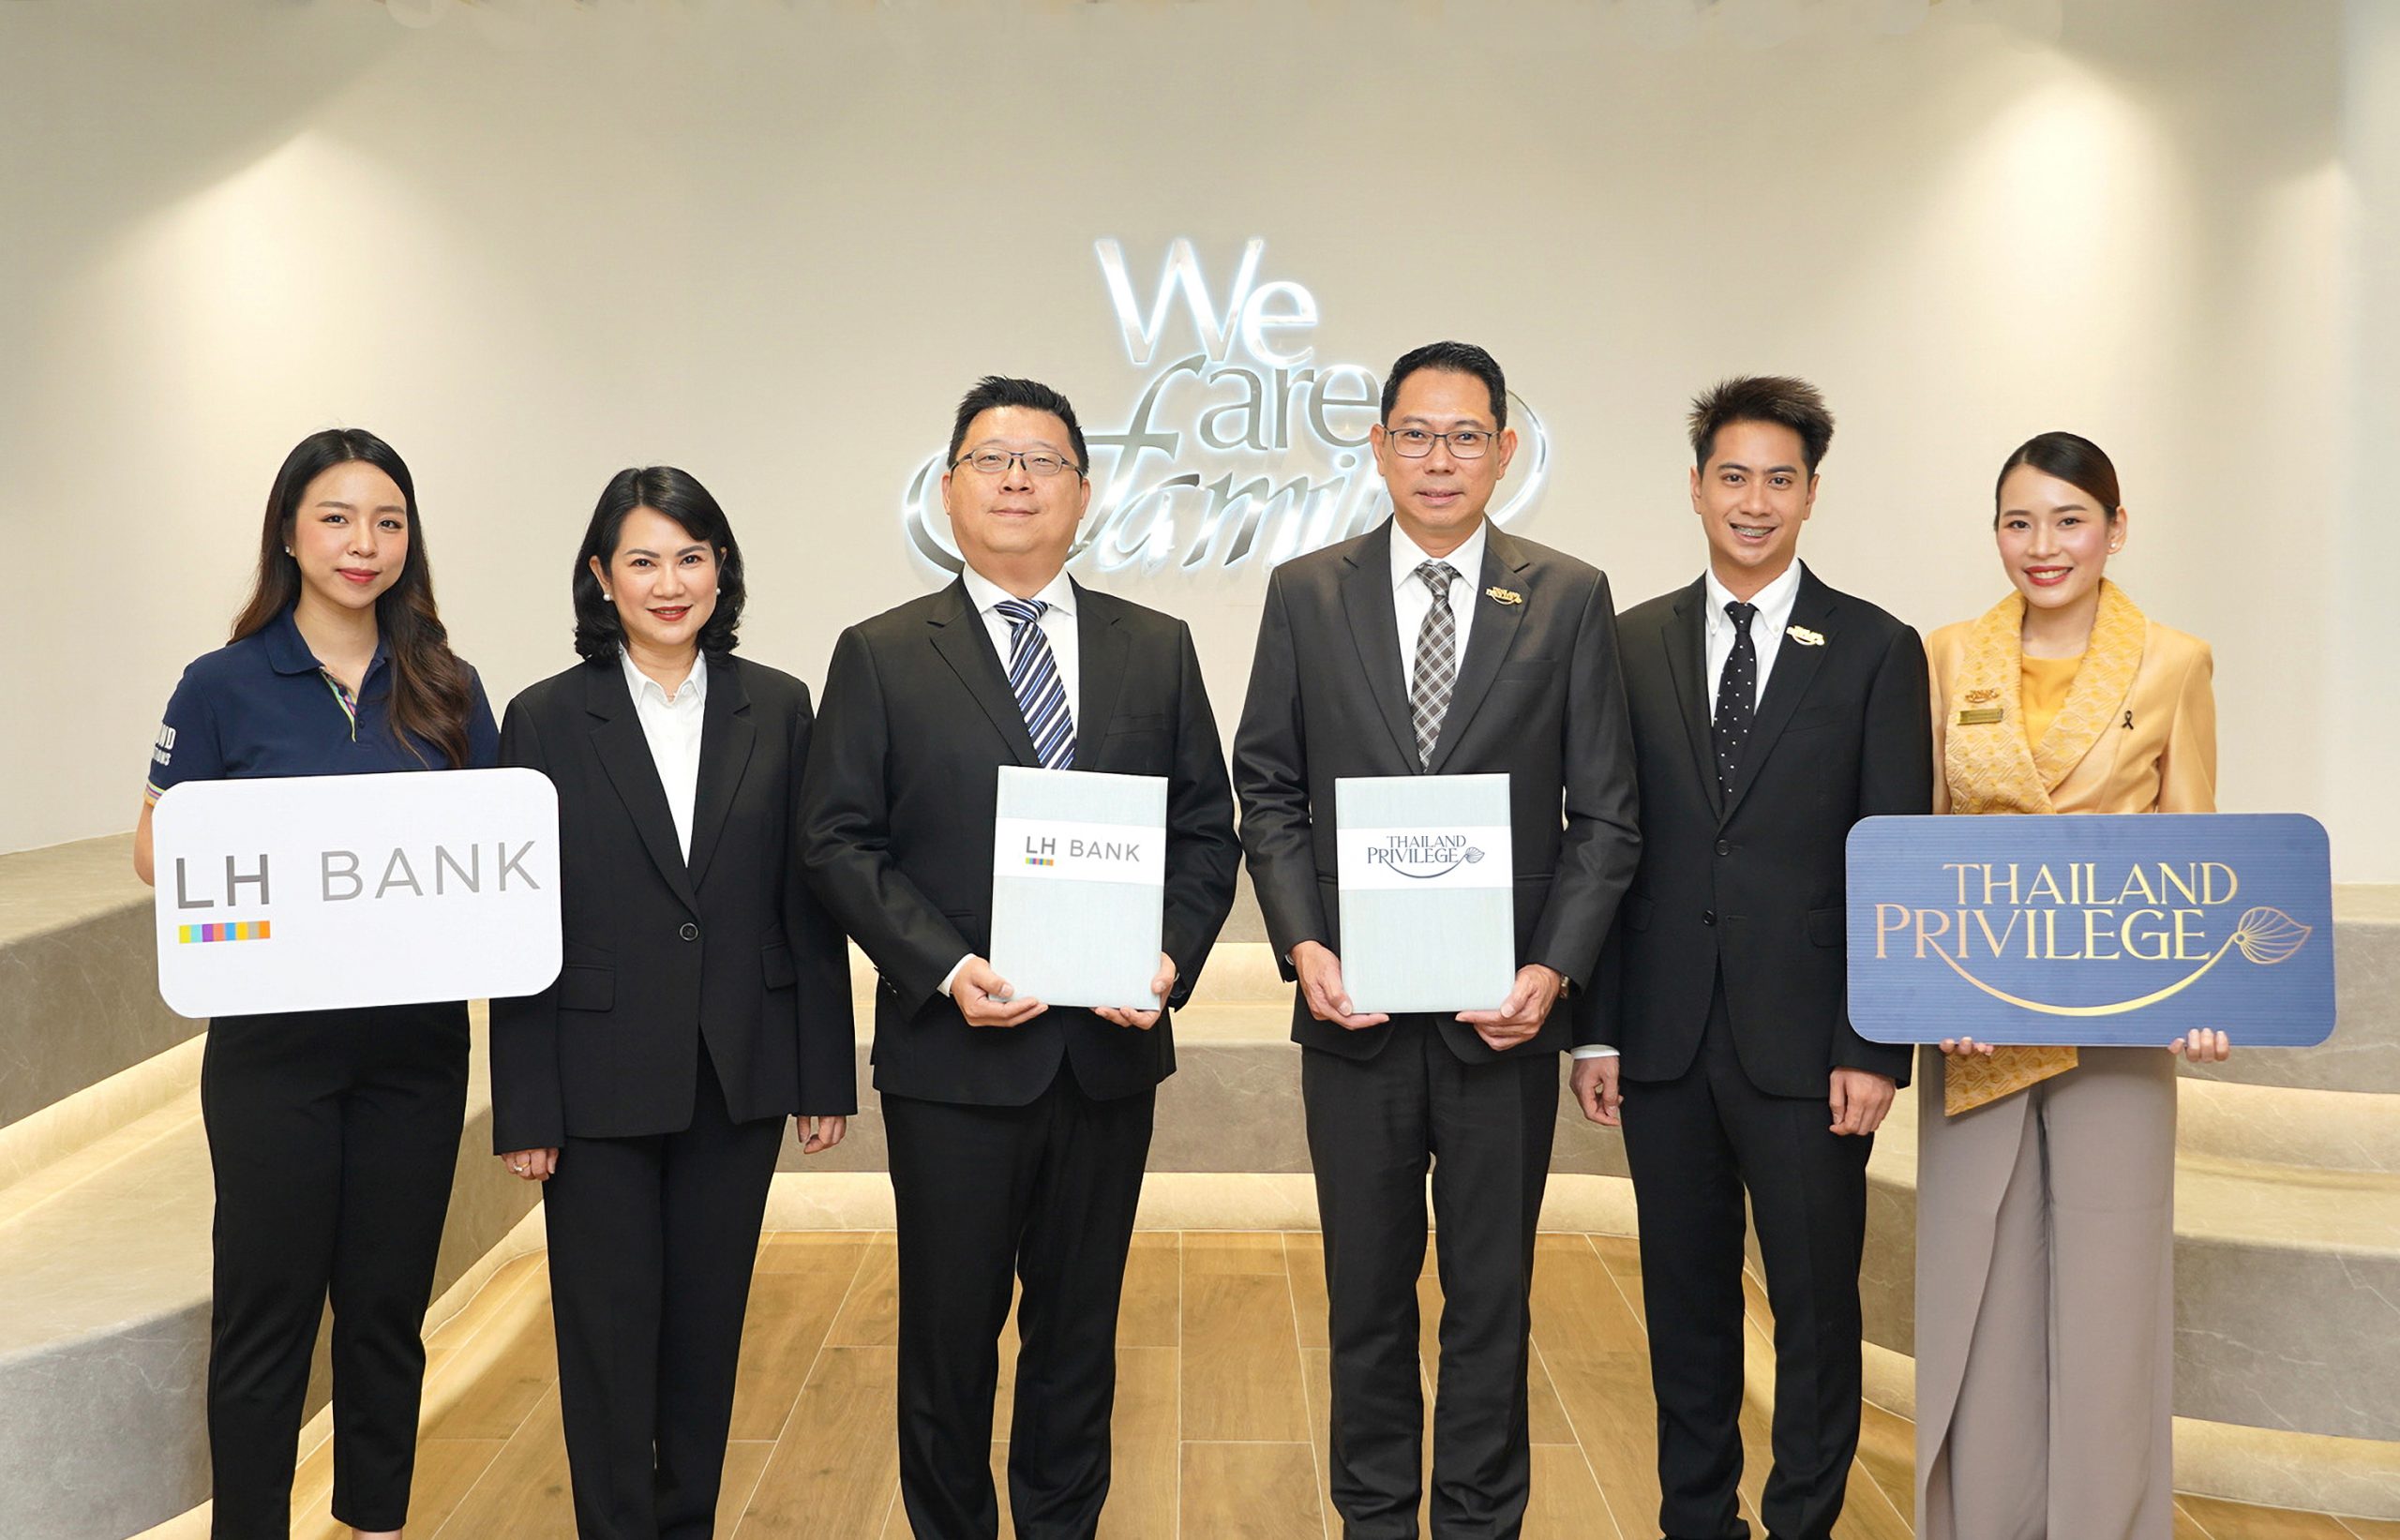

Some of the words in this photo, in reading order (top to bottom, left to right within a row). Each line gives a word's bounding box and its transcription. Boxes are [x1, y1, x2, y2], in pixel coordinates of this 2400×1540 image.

[1094, 237, 1317, 366] We
[1026, 835, 1056, 855] LH
[1070, 839, 1140, 862] BANK
[1367, 846, 1460, 864] PRIVILEGE
[1386, 835, 1467, 848] THAILAND
[175, 853, 270, 909] LH
[321, 840, 541, 902] BANK
[1942, 861, 2239, 905] THAILAND
[1874, 903, 2212, 961] PRIVILEGE
